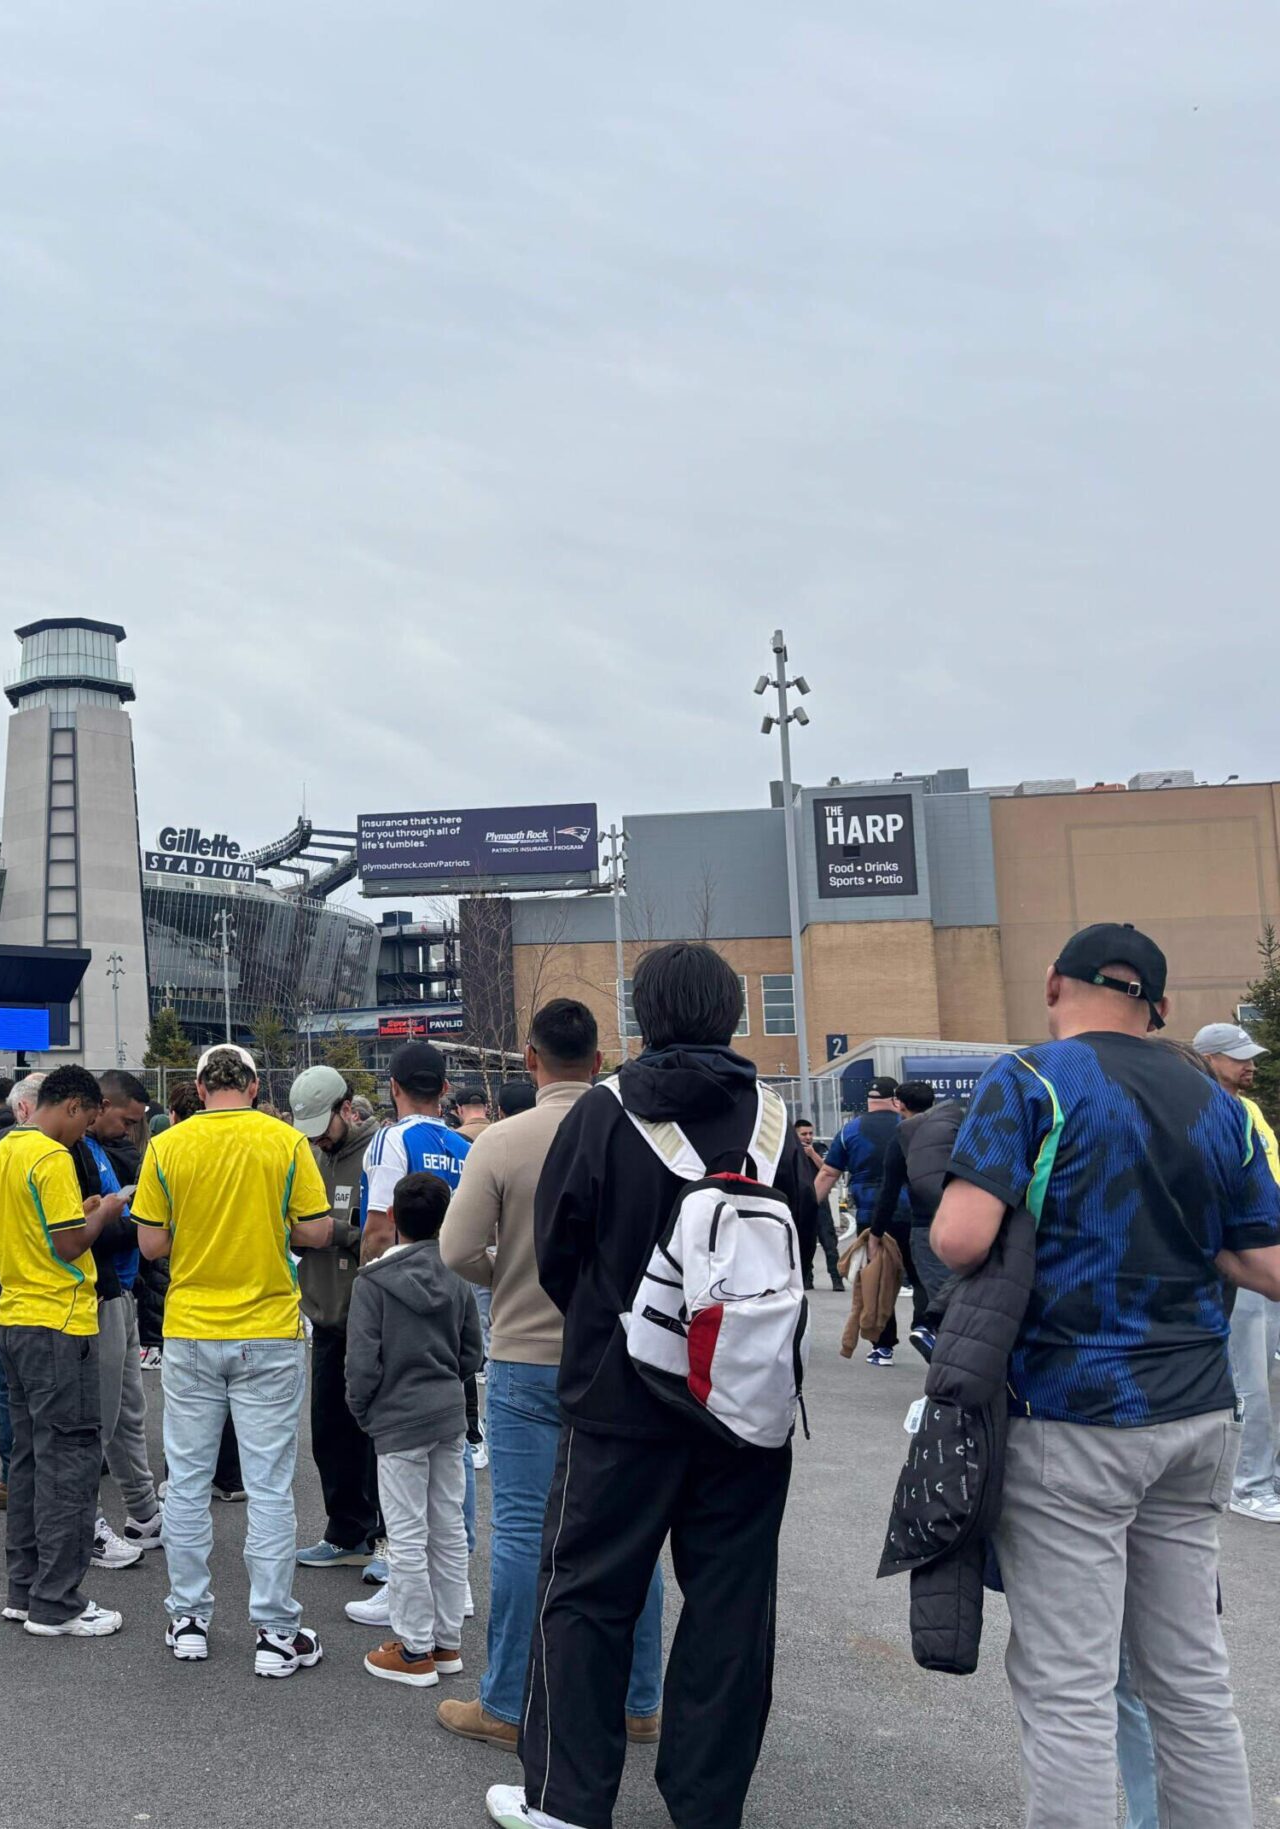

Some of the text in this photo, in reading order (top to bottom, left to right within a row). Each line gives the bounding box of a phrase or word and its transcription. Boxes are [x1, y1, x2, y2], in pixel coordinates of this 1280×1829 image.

[824, 805, 844, 816] THE
[361, 815, 462, 828] Insurance that's here
[362, 827, 461, 840] for you through all of
[485, 829, 549, 841] Plymouth Rock
[826, 814, 904, 845] HARP
[159, 827, 241, 860] Gillette
[362, 840, 428, 850] life's fumbles.
[150, 855, 250, 880] STADIUM
[362, 859, 471, 872] plymouthrock.com/Patriots
[828, 861, 899, 874] Food Drinks
[829, 874, 903, 888] Sports Patio
[429, 1019, 463, 1029] PAVILIO
[832, 1038, 843, 1056] 2
